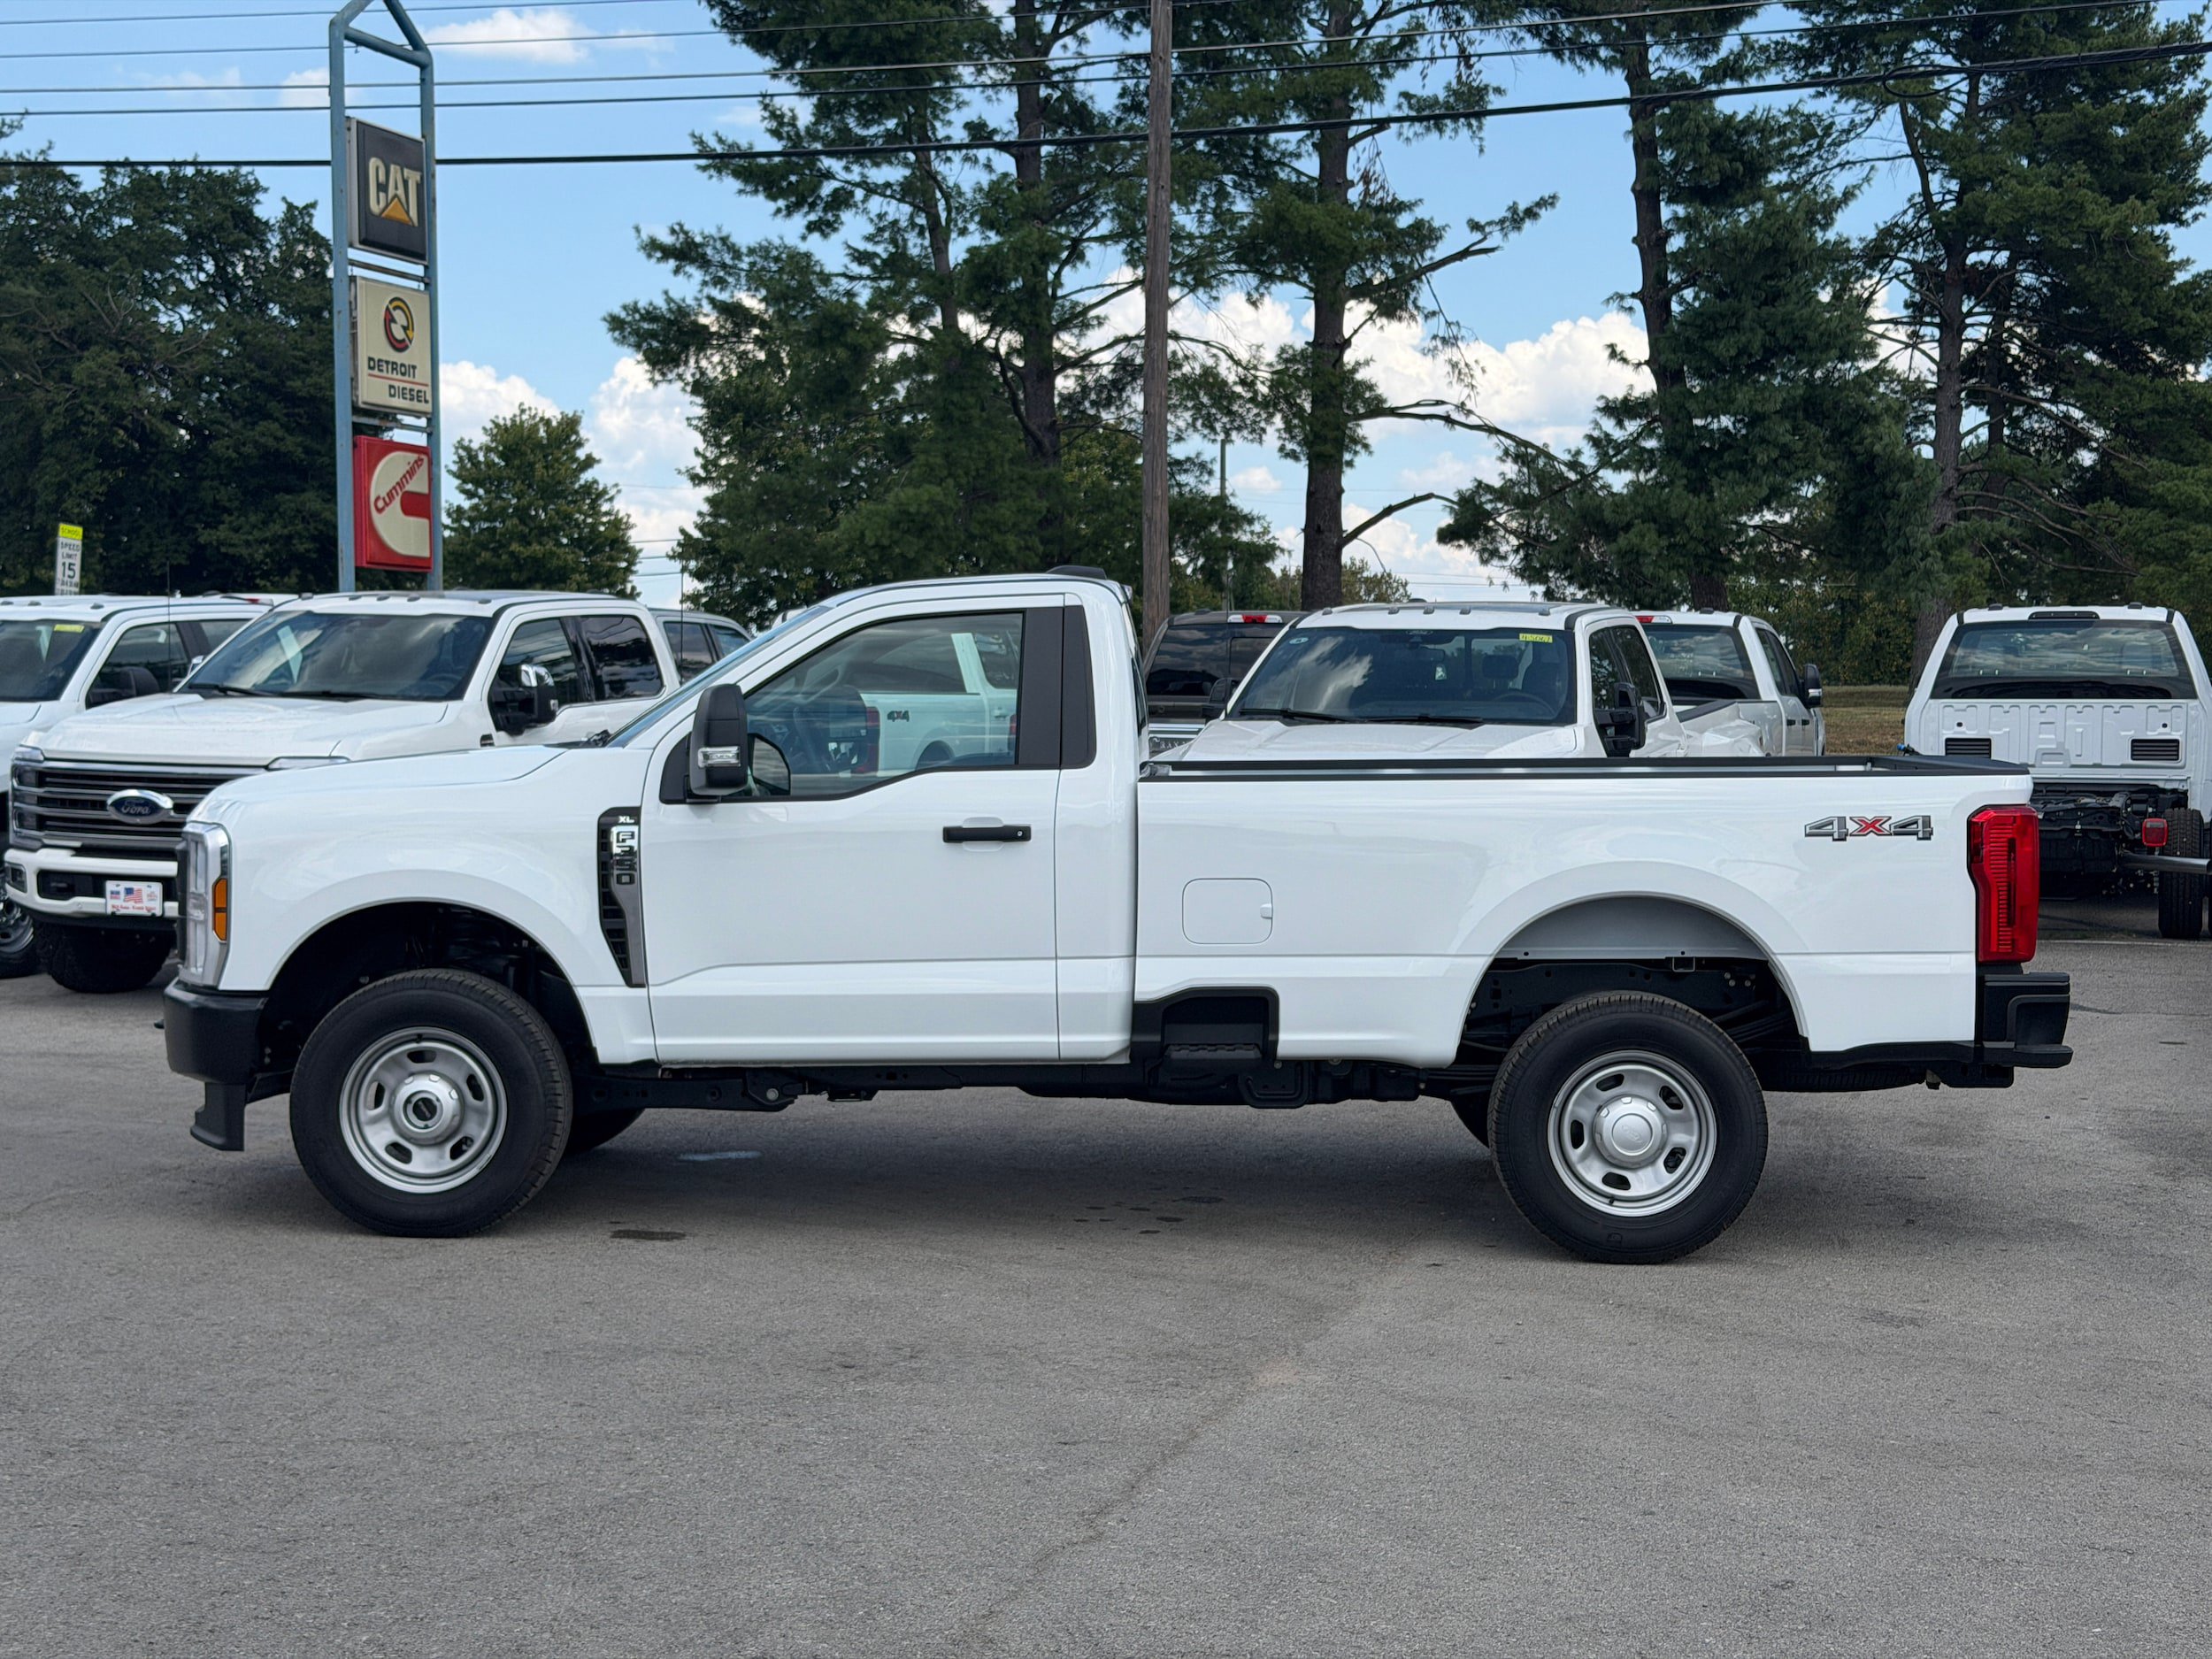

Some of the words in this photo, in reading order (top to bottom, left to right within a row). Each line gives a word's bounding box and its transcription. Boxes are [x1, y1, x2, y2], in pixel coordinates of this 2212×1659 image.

[368, 157, 422, 227] CAT
[367, 356, 418, 380] DETROIT
[388, 384, 430, 404] DIESEL
[373, 455, 425, 515] Cummins
[61, 541, 81, 552] SPEED
[62, 551, 78, 560] LIMIT
[62, 561, 76, 580] 15
[121, 799, 151, 815] Ford
[618, 815, 635, 824] XL
